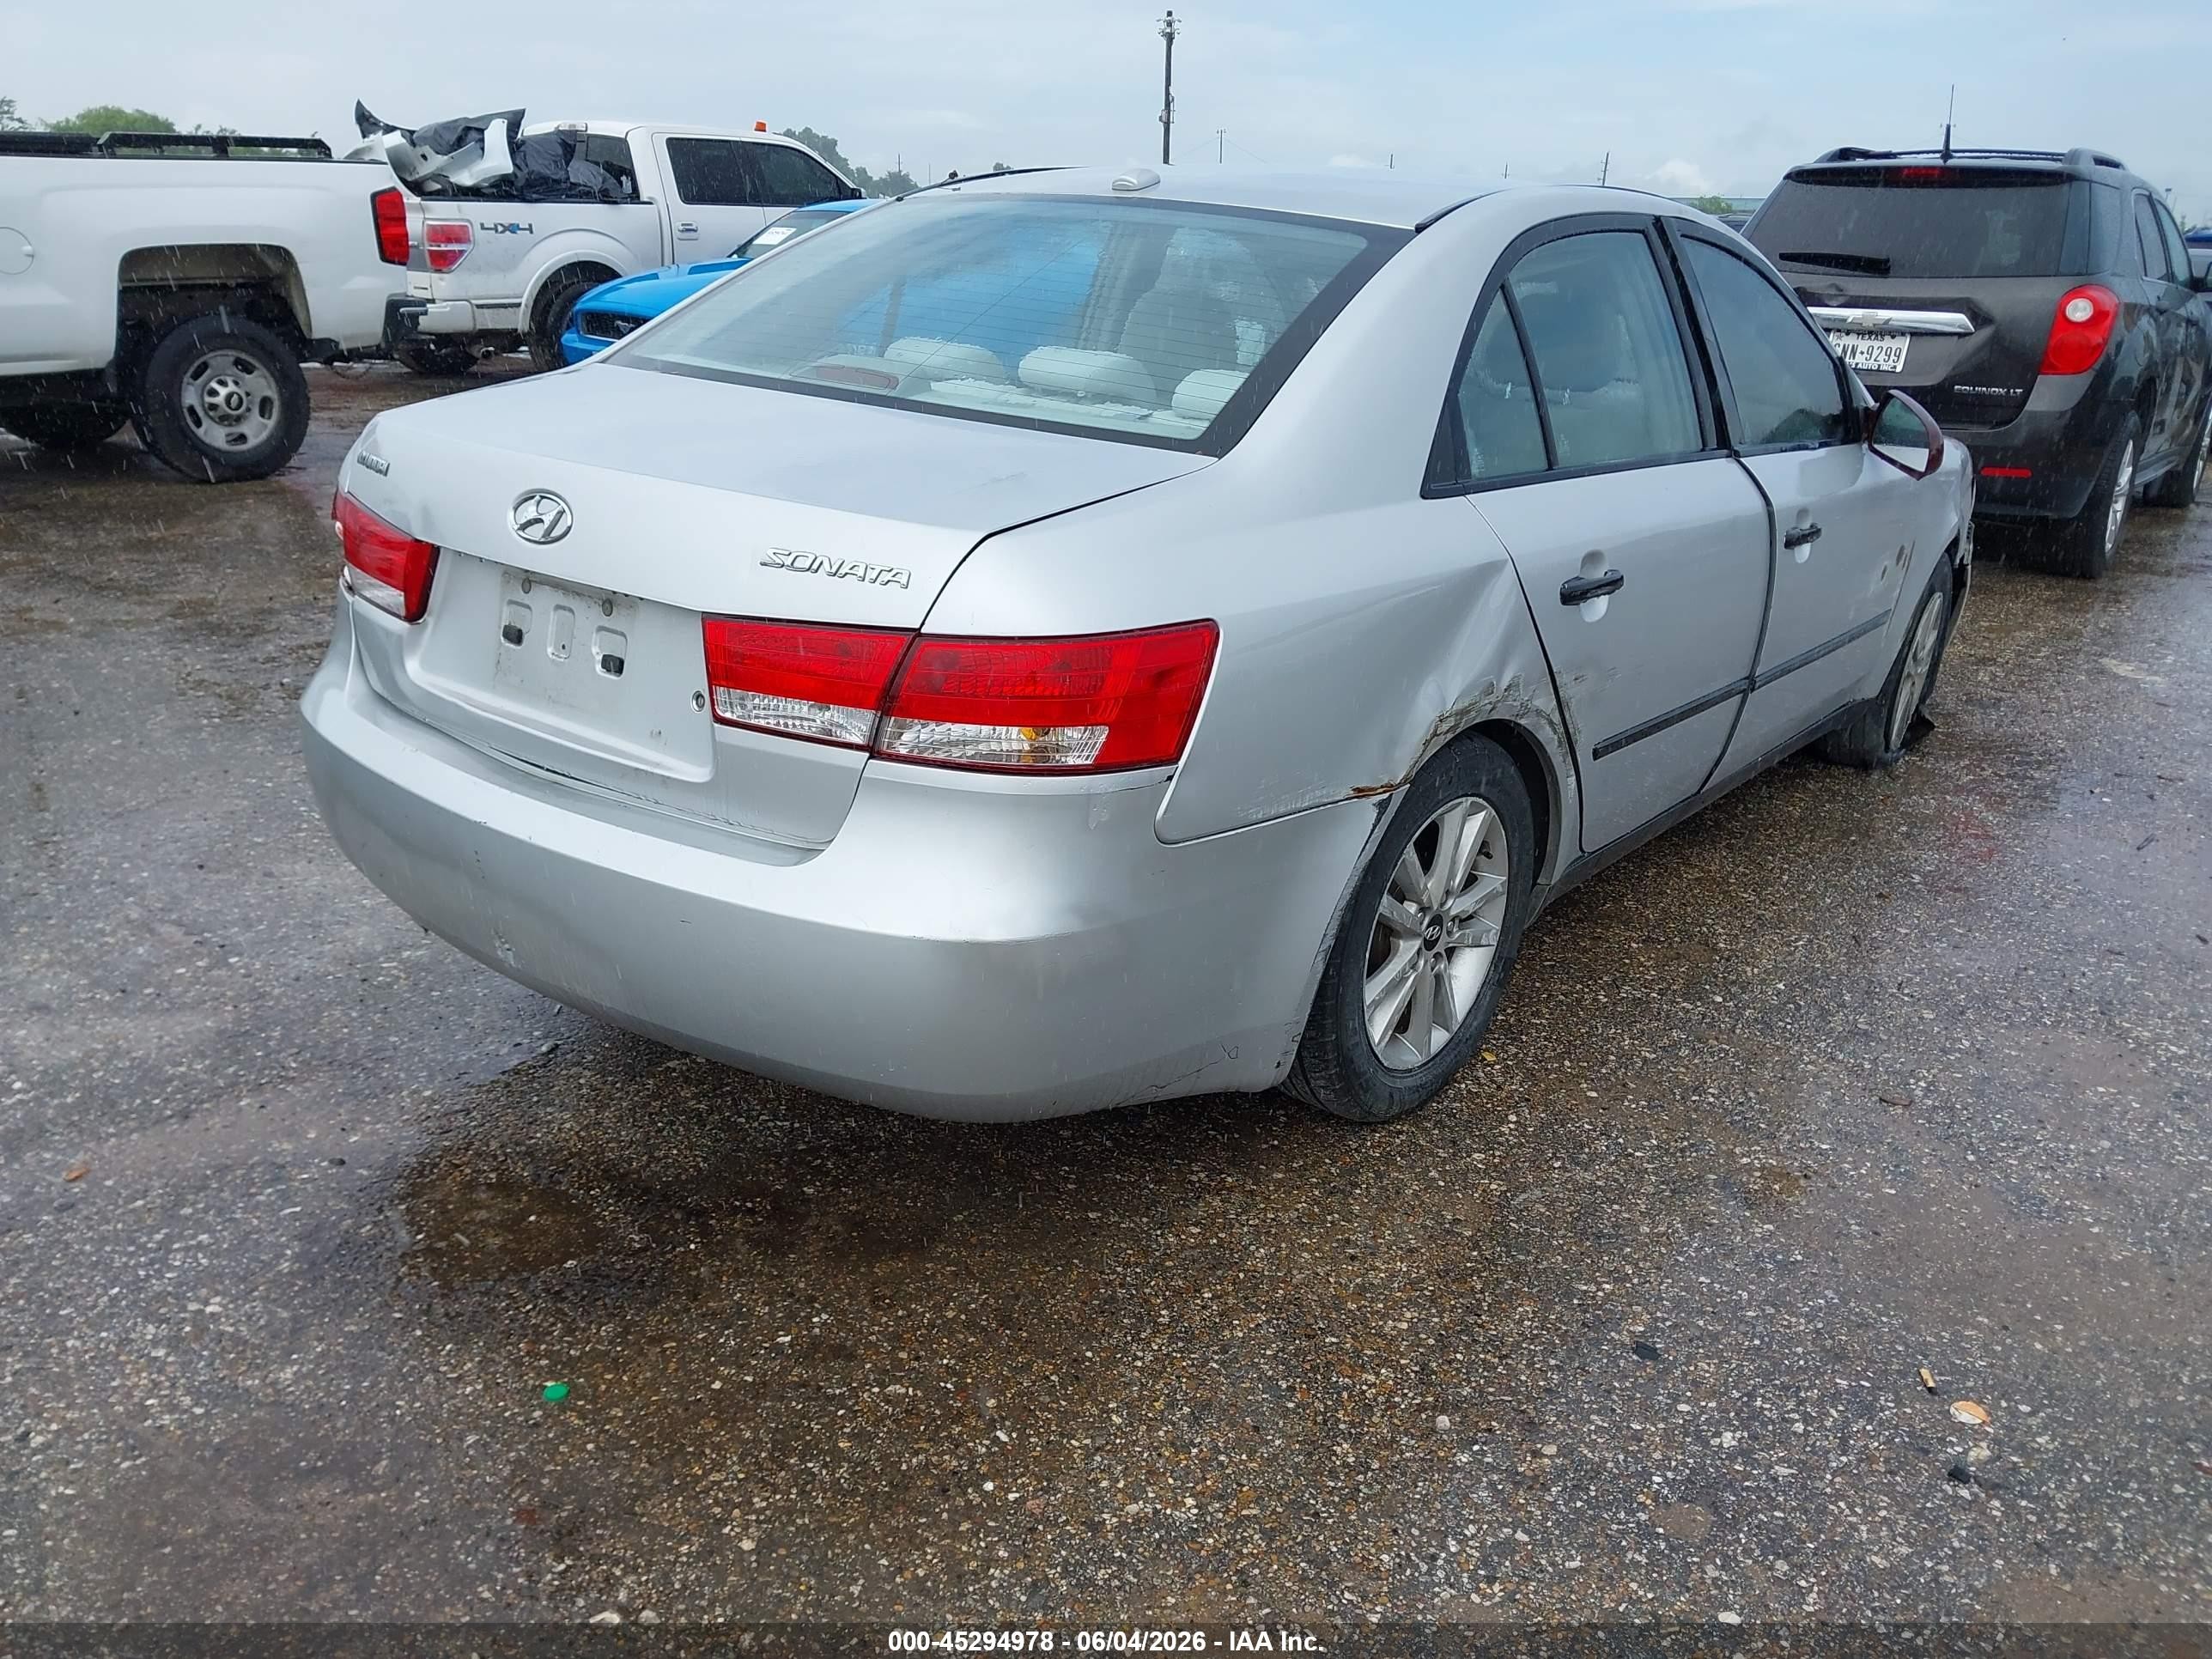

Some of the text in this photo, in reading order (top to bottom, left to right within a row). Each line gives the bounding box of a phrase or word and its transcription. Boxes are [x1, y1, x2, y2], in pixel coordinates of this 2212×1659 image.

[1856, 332, 1885, 342] TEXAS
[1954, 385, 2008, 395] EQUINOX
[760, 547, 911, 589] SONATA
